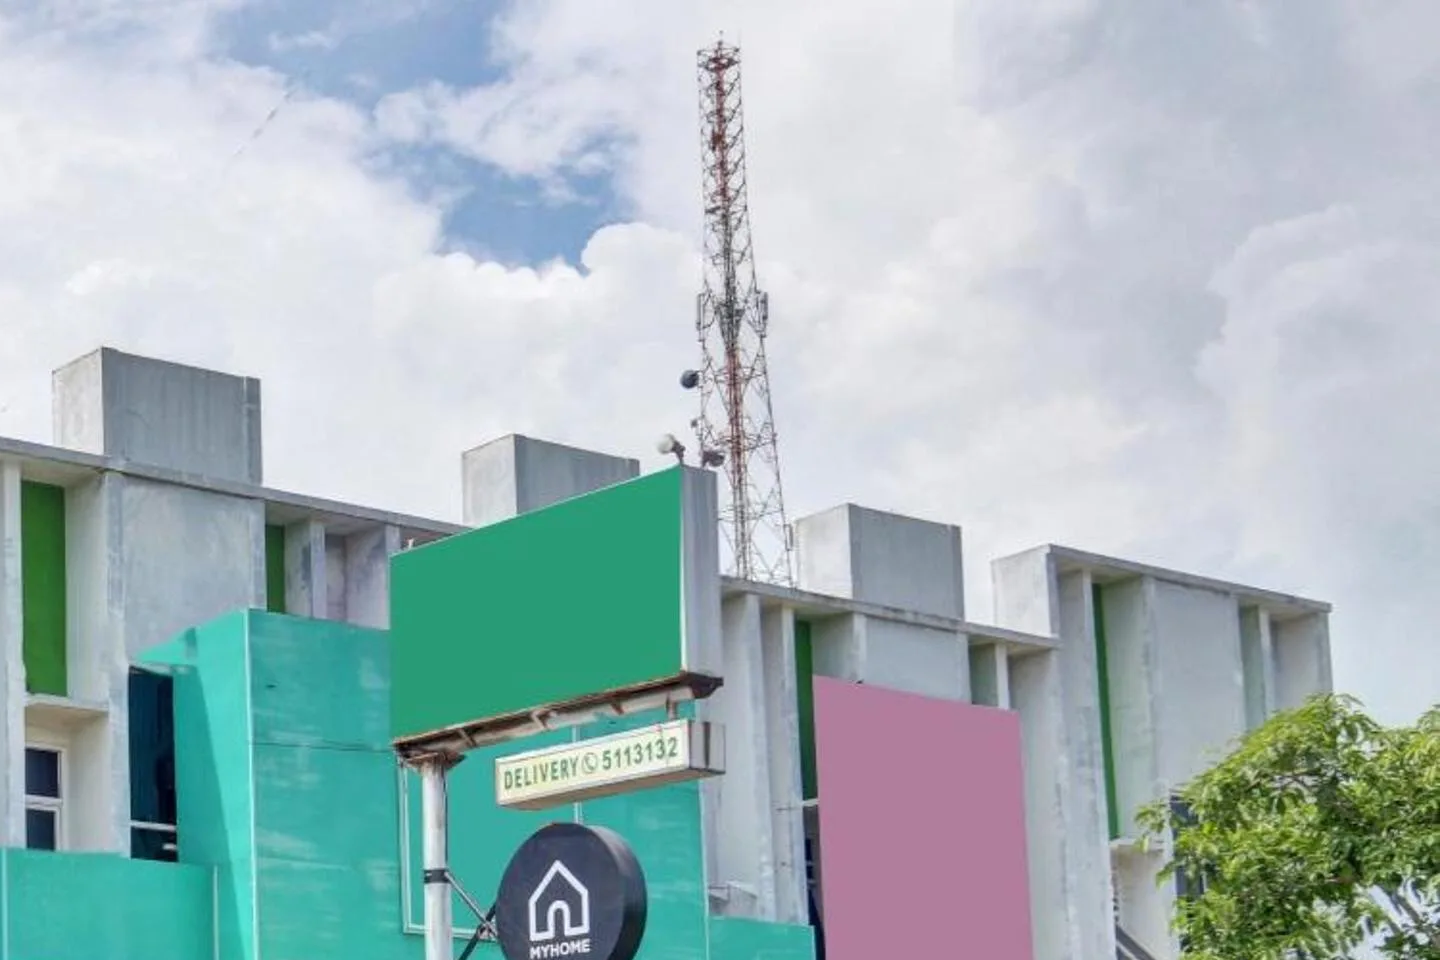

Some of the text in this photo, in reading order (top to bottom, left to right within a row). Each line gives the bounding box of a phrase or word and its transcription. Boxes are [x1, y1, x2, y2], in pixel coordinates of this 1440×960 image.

[504, 736, 678, 790] DELIVERY 5113132
[530, 938, 591, 960] MYHOME
